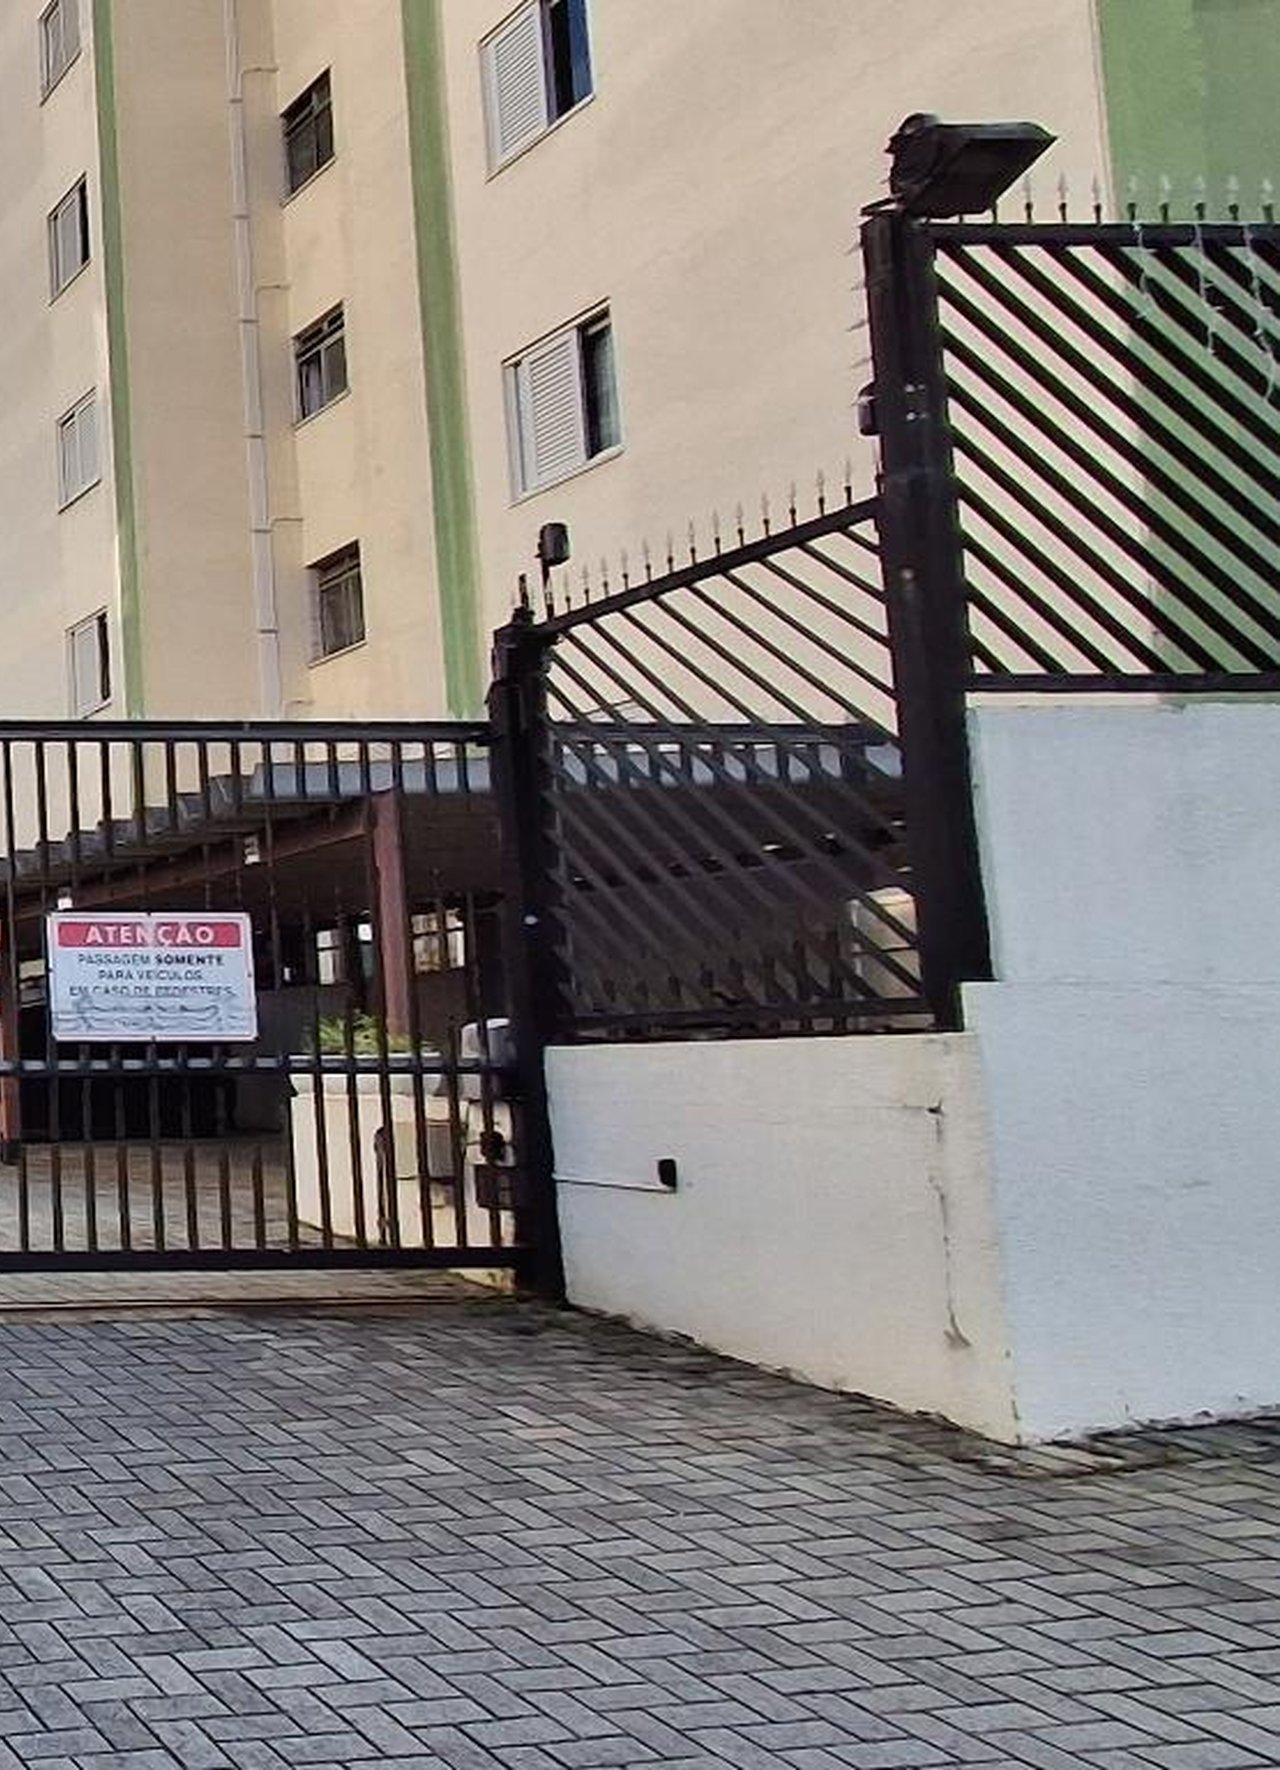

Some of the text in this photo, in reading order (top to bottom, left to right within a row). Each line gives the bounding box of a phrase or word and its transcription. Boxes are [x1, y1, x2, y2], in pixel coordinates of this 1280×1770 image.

[77, 953, 225, 966] PASSAGEM SOMENTE
[98, 969, 134, 981] PARA
[69, 986, 89, 997] EM
[93, 986, 129, 998] CASO
[134, 986, 150, 997] DE
